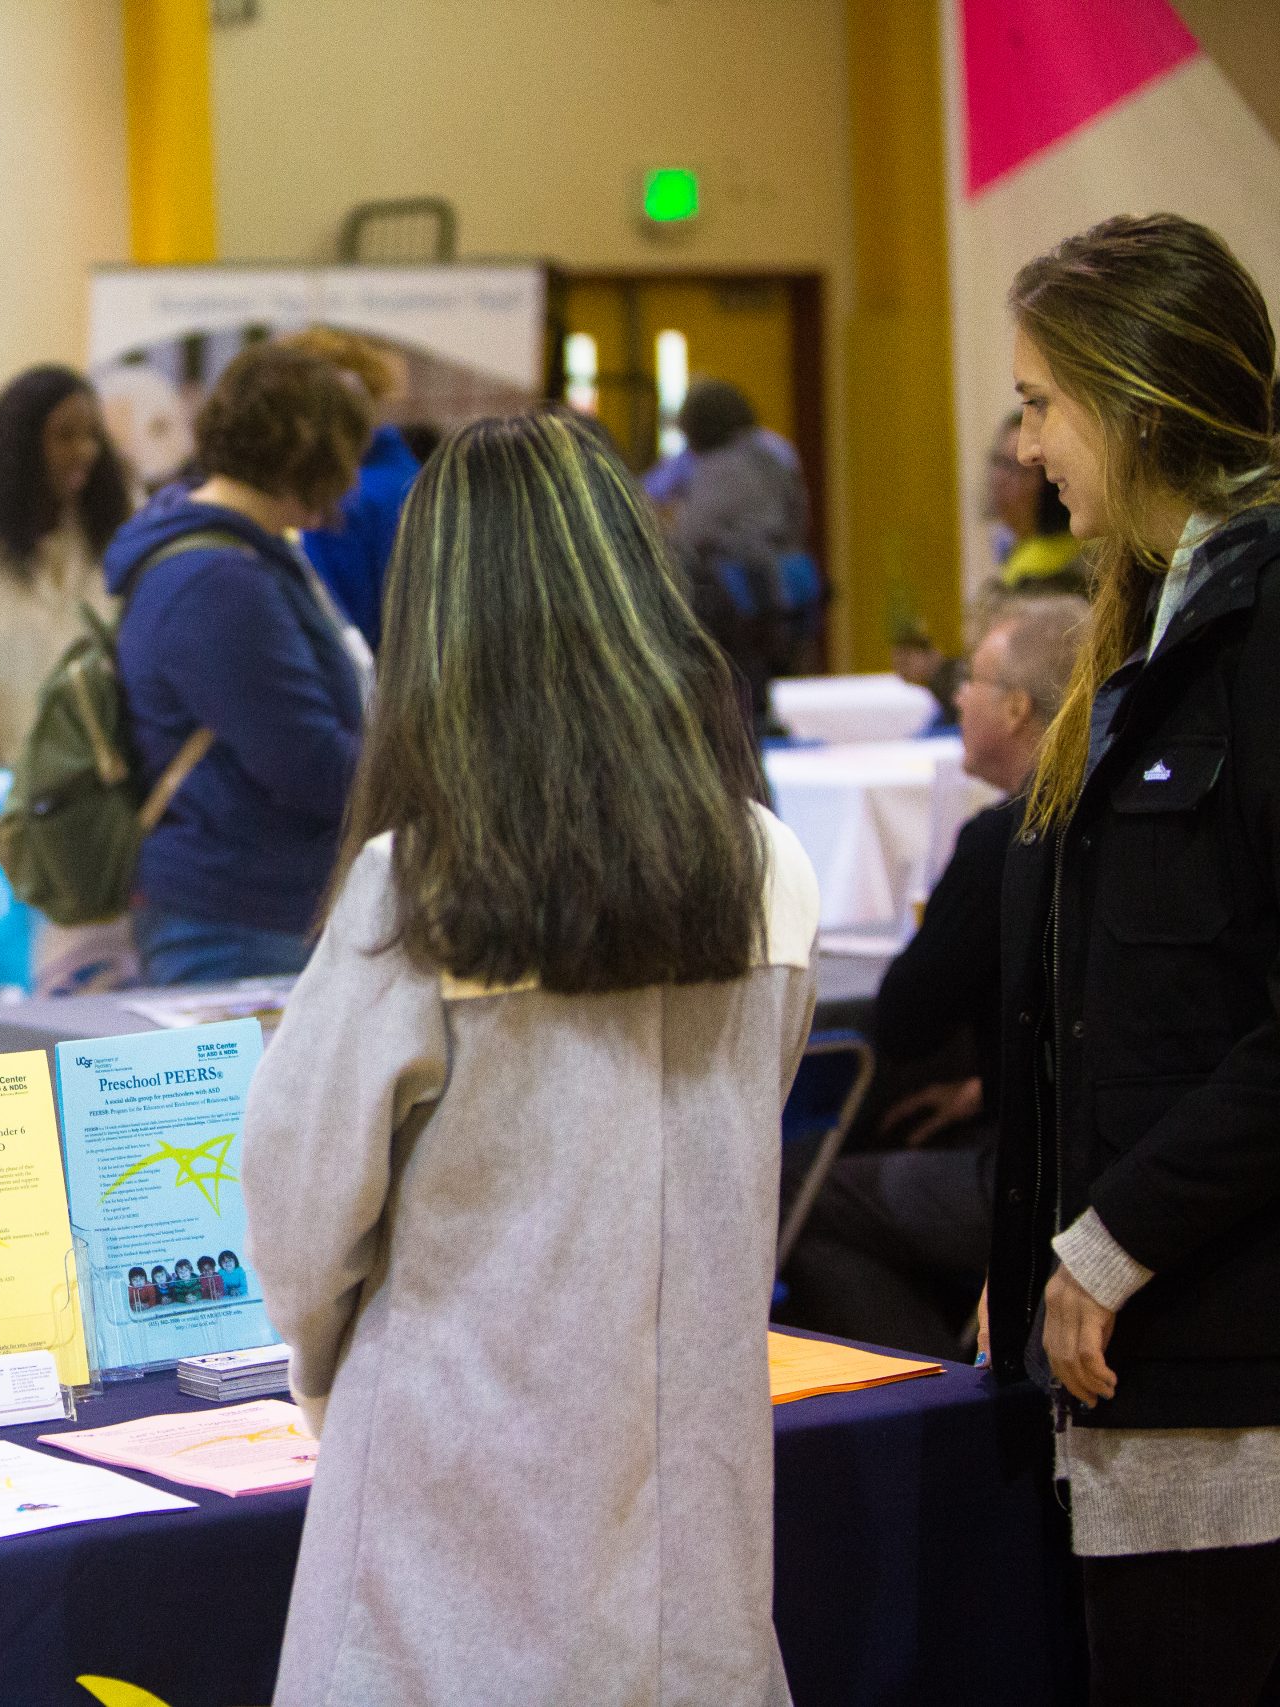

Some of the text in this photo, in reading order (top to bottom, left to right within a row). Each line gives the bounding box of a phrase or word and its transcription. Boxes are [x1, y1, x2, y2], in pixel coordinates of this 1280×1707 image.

[196, 1040, 238, 1052] STAR Center
[75, 1055, 92, 1069] UCSF
[9, 1082, 28, 1091] NDDs
[98, 1071, 161, 1092] Preschool
[138, 1095, 152, 1103] group
[162, 1089, 194, 1100] preschoolers
[20, 1125, 26, 1134] 6
